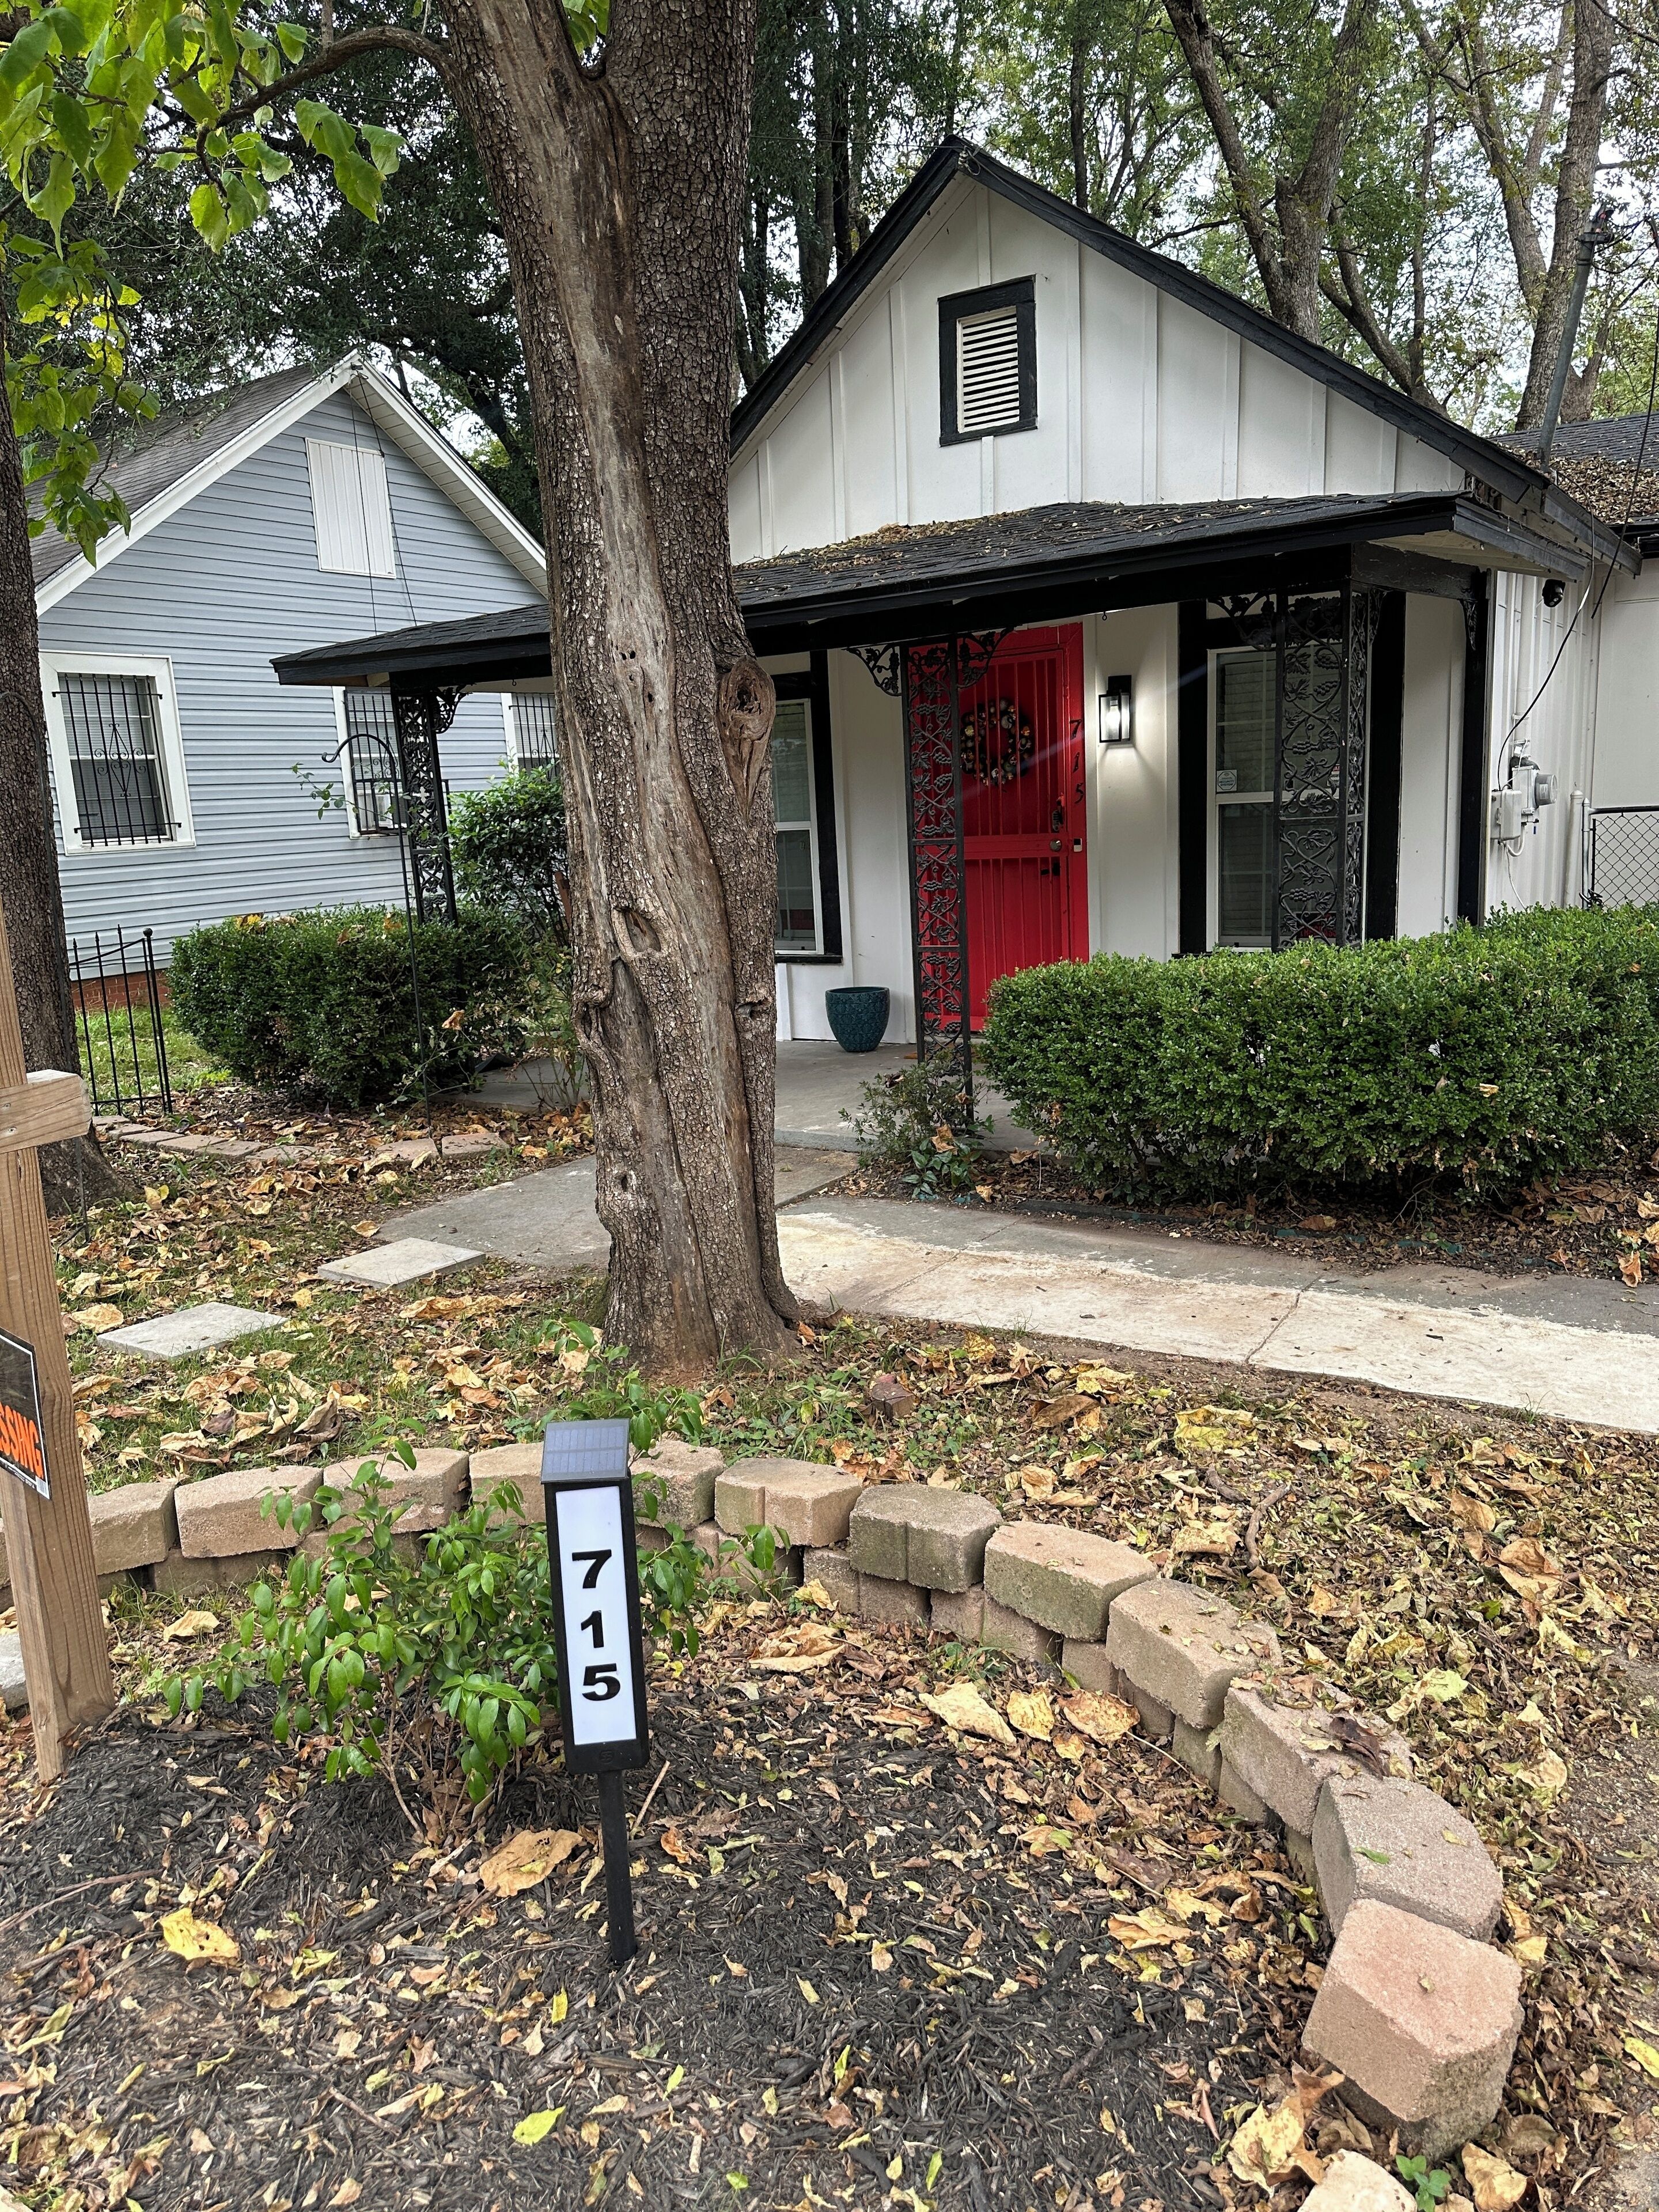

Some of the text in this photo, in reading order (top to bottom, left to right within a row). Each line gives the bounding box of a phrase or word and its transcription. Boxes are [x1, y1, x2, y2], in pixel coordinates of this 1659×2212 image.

[1070, 719, 1084, 804] 715
[0, 1401, 44, 1480] SSING
[572, 1549, 621, 1702] 715
